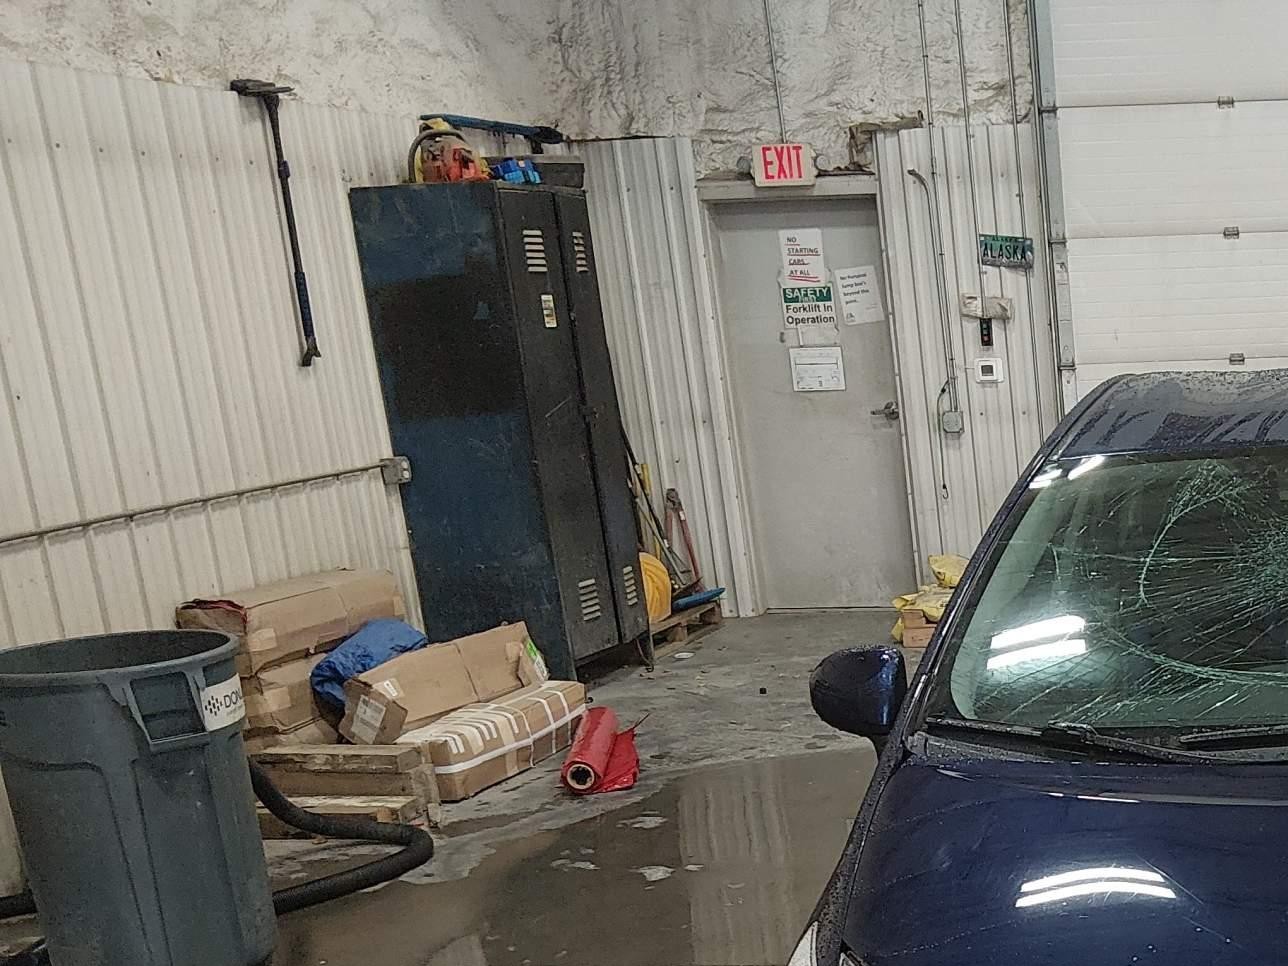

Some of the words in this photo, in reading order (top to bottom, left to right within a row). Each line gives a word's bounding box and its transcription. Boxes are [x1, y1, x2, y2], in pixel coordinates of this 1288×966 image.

[761, 145, 803, 179] EXIT
[982, 242, 1027, 261] ALASKA
[785, 287, 828, 299] SAFETY
[785, 303, 821, 314] Forklift
[823, 303, 833, 313] In
[785, 314, 835, 326] Operation
